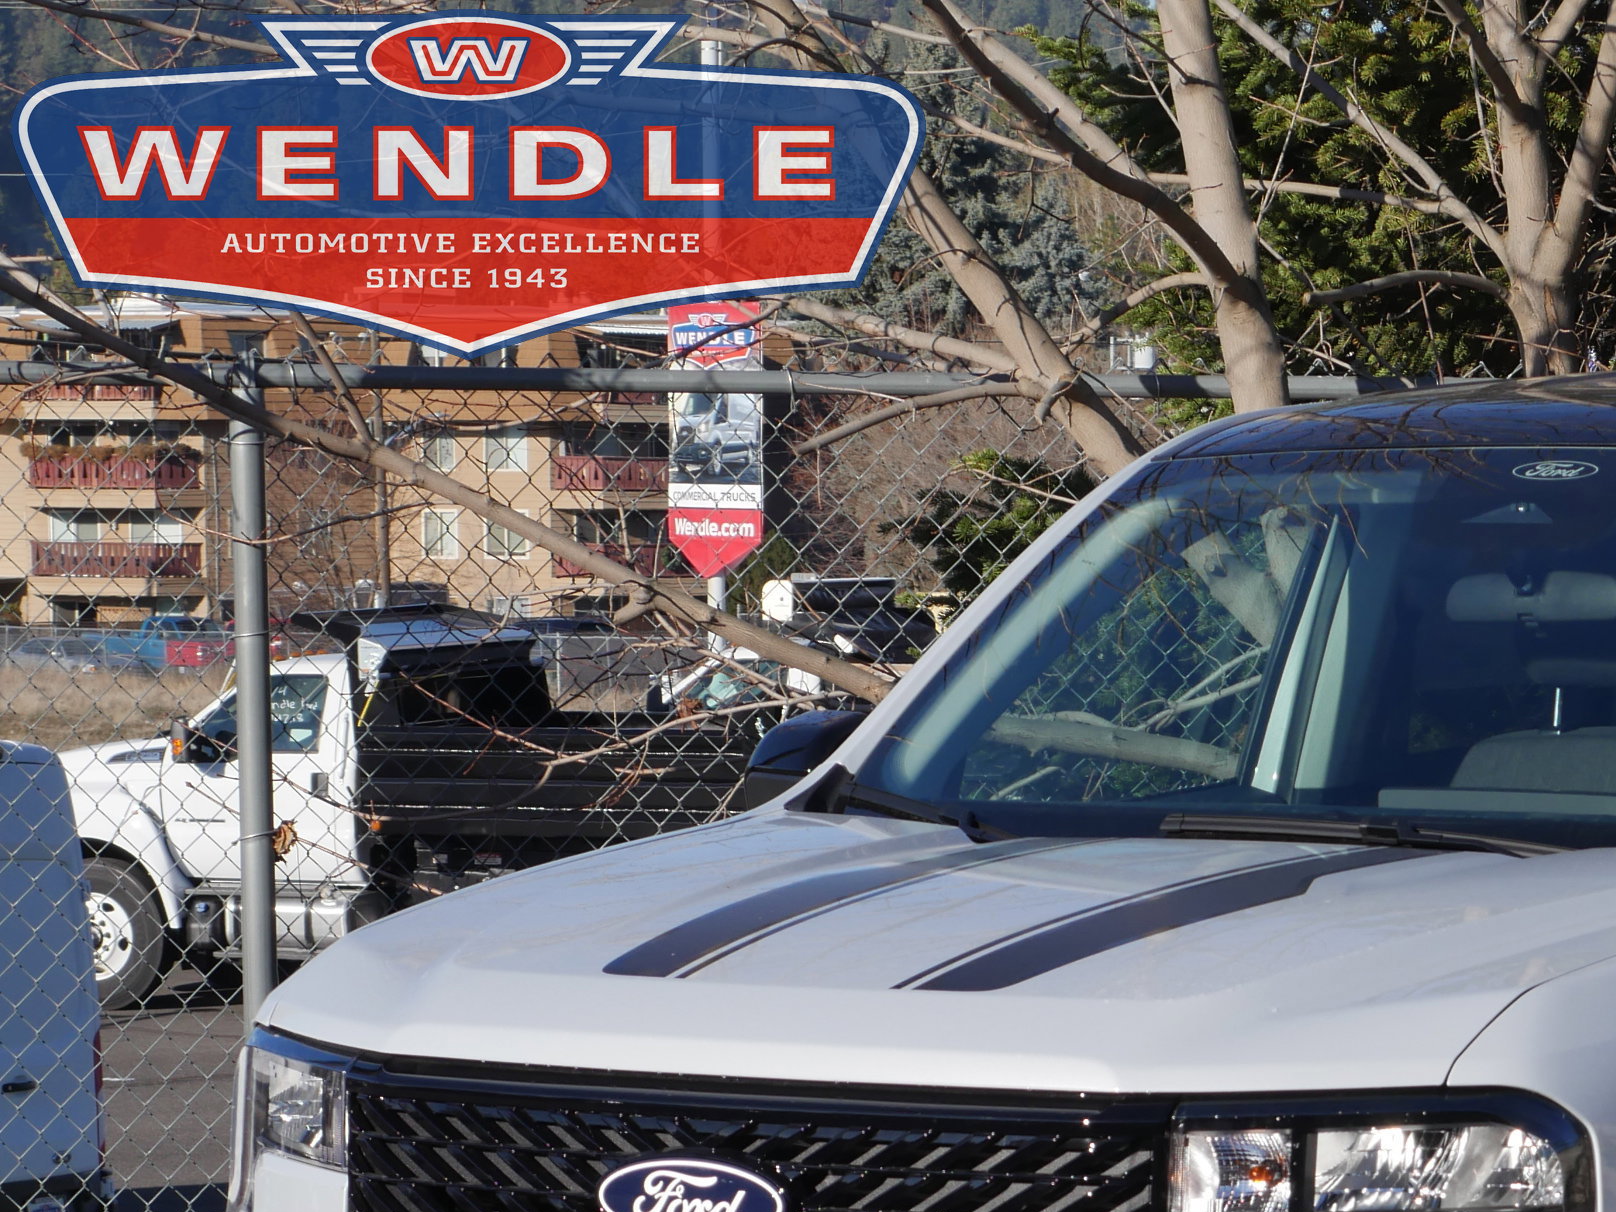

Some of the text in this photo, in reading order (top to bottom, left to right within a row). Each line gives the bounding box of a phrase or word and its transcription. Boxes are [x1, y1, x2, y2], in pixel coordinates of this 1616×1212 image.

[1525, 463, 1585, 477] Ford
[673, 491, 756, 502] COMMERCIAL TRUCKS
